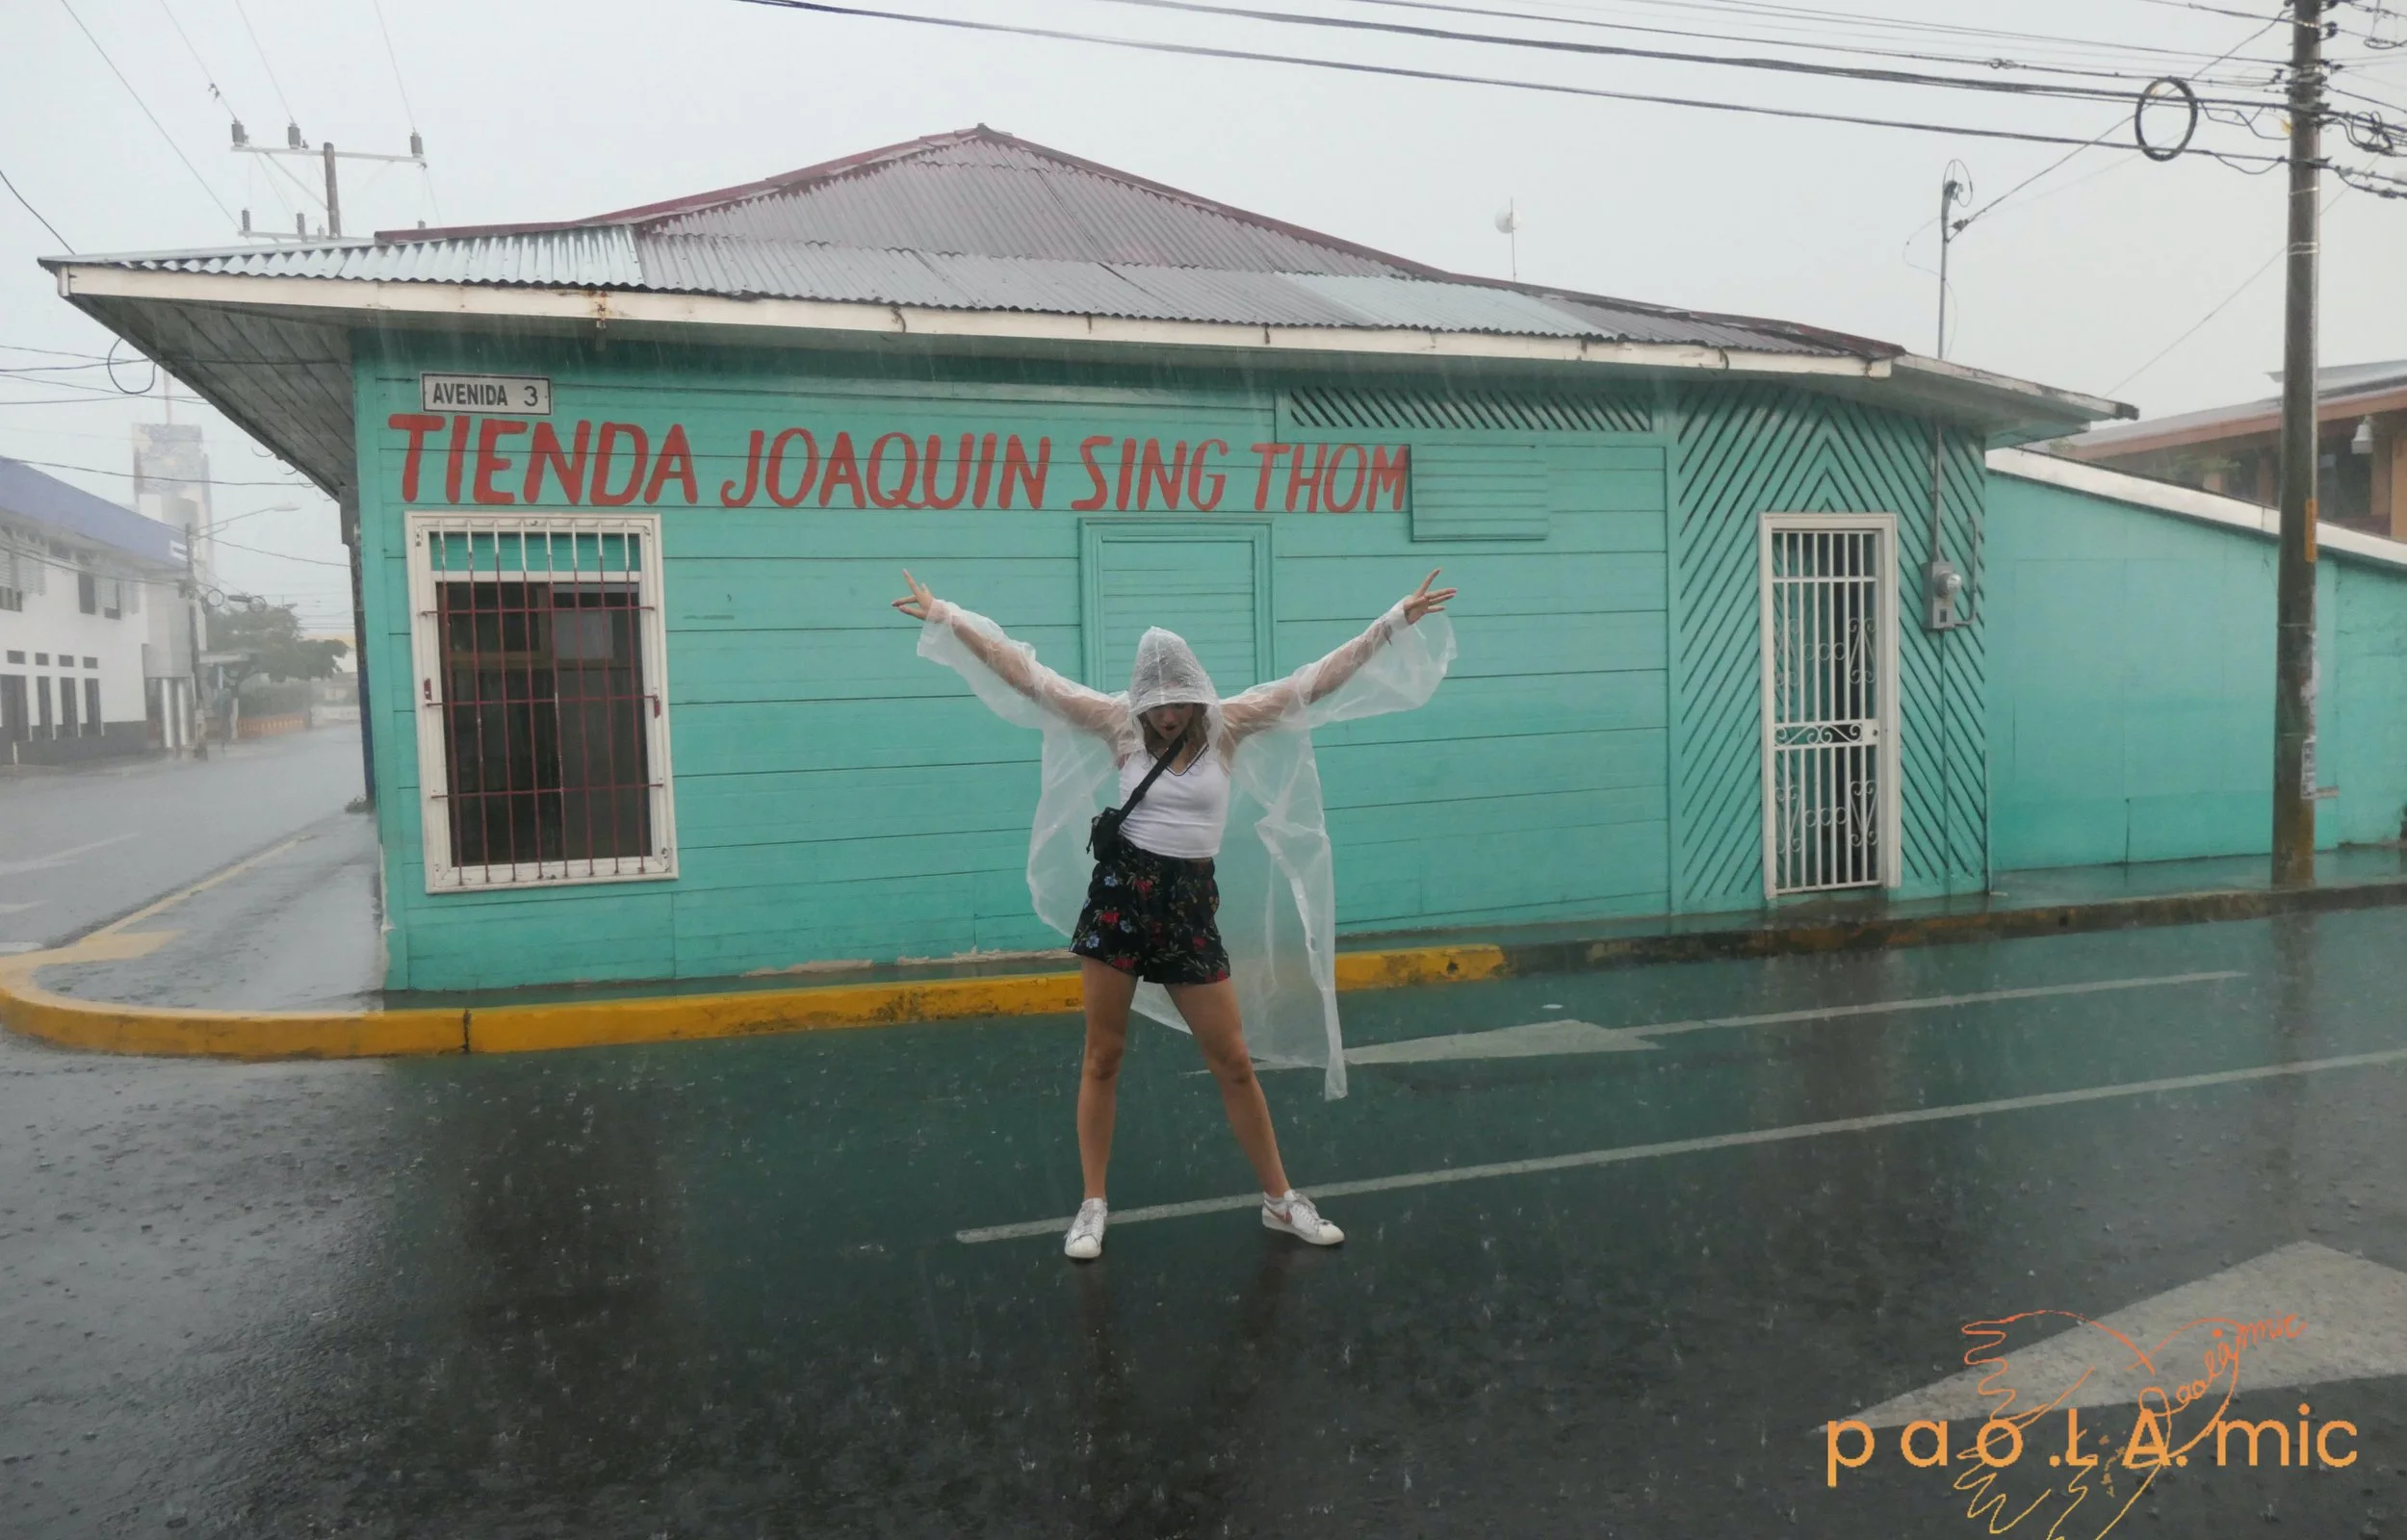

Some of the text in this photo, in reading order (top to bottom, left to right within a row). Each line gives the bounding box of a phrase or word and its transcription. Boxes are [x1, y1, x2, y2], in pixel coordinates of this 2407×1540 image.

[432, 382, 539, 407] AVENIDA 3
[388, 413, 1408, 514] TIENDA JOAQUIN SING THOM
